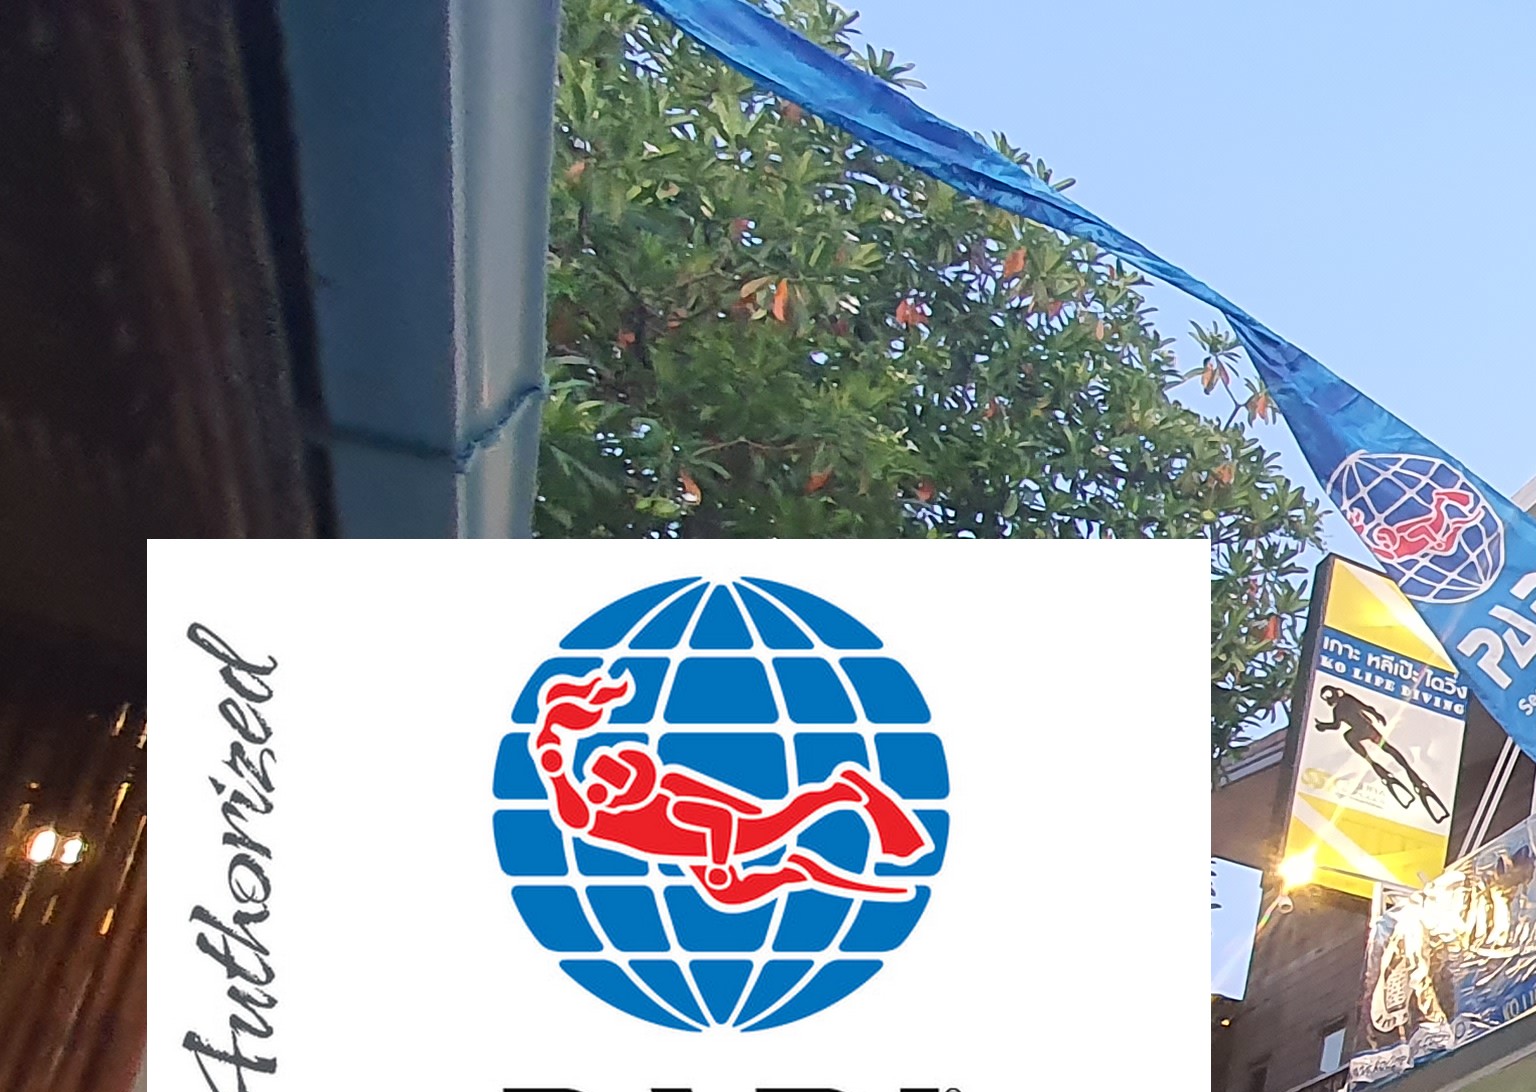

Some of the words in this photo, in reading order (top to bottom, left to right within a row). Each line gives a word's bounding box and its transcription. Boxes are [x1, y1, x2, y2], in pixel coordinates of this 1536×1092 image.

[1323, 635, 1361, 661] เกาะ
[1320, 655, 1348, 675] KO
[1351, 665, 1395, 692] LIPE
[1400, 683, 1466, 716] DIVING
